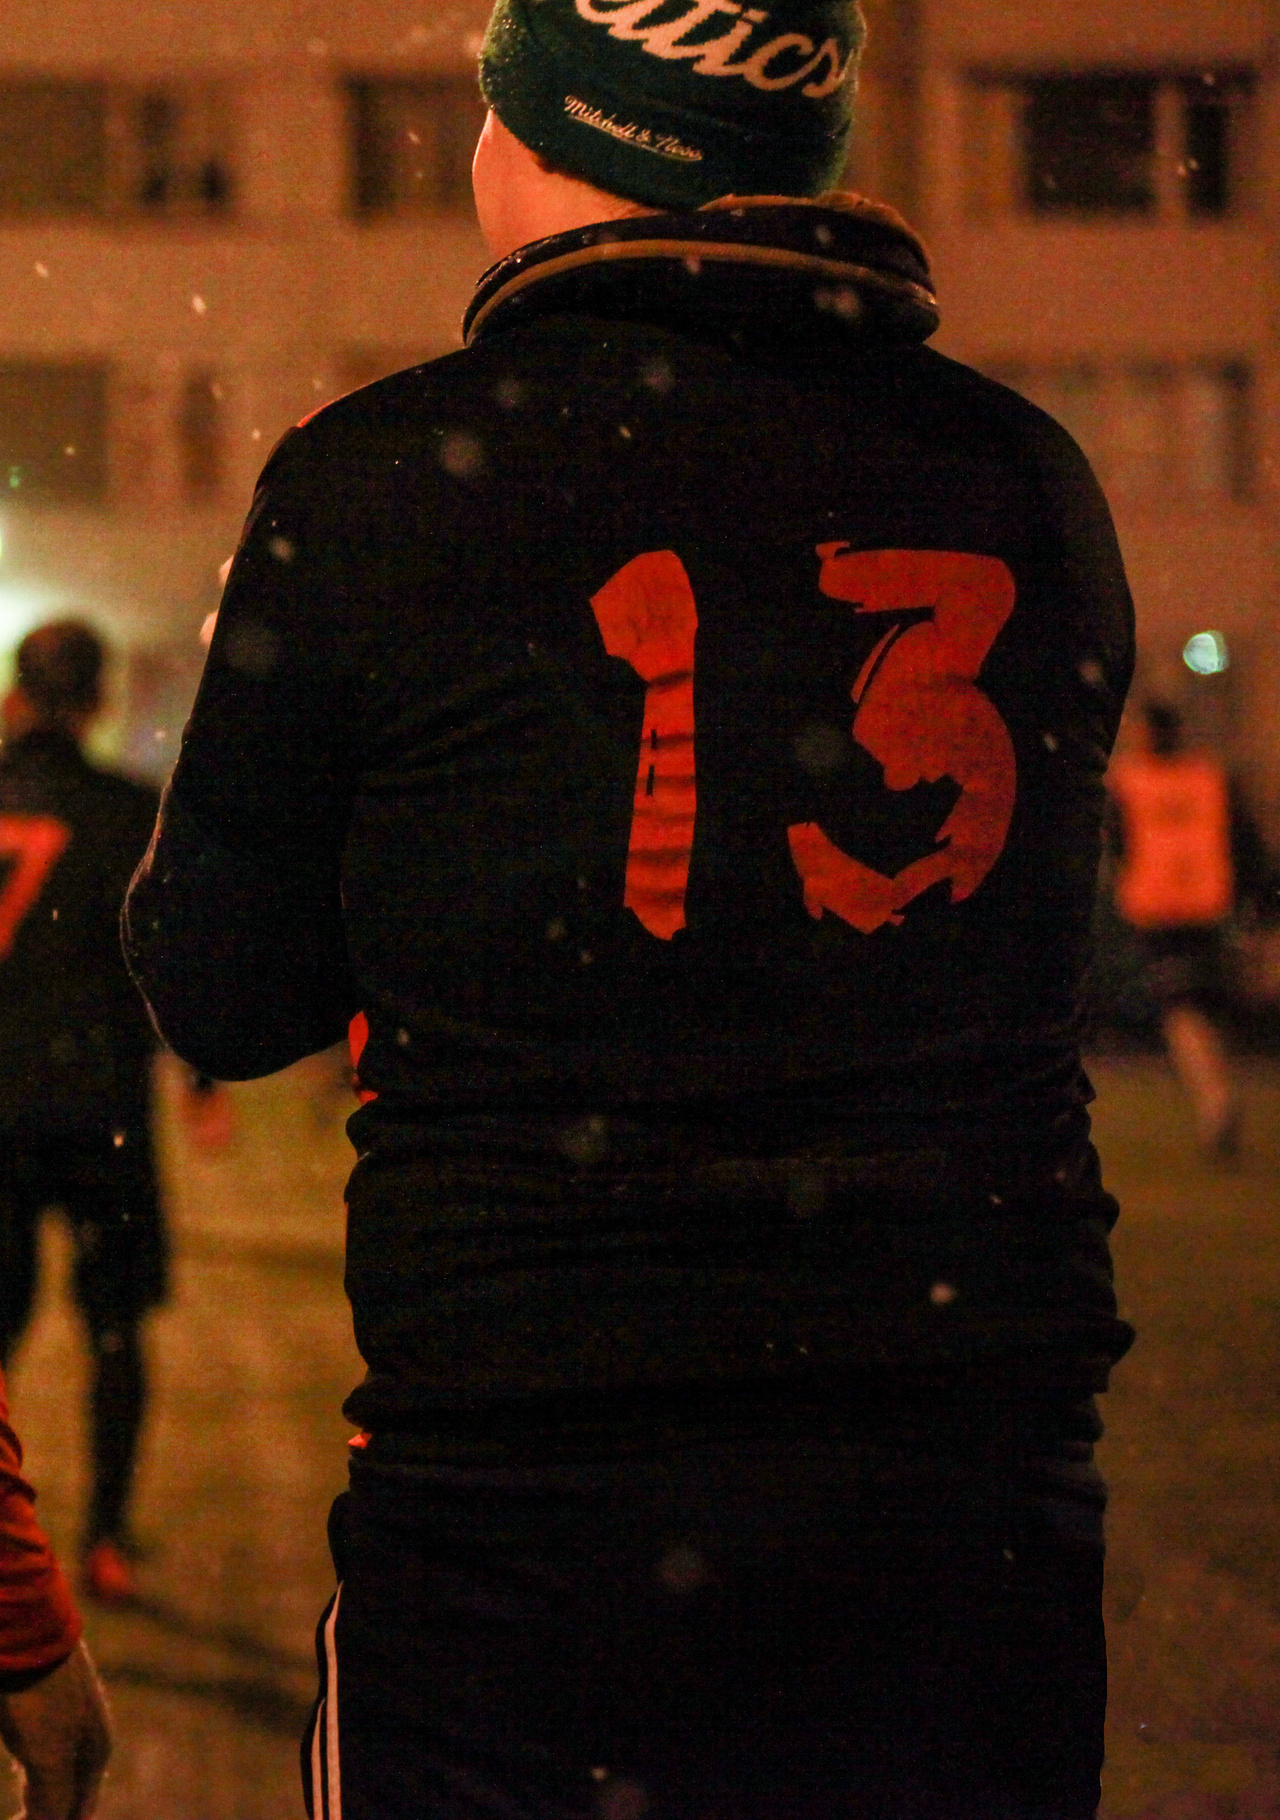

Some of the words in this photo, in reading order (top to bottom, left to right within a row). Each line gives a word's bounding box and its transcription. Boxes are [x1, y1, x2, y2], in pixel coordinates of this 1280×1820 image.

[564, 95, 638, 140] Mitchell
[635, 128, 651, 142] &
[590, 541, 1016, 940] 13
